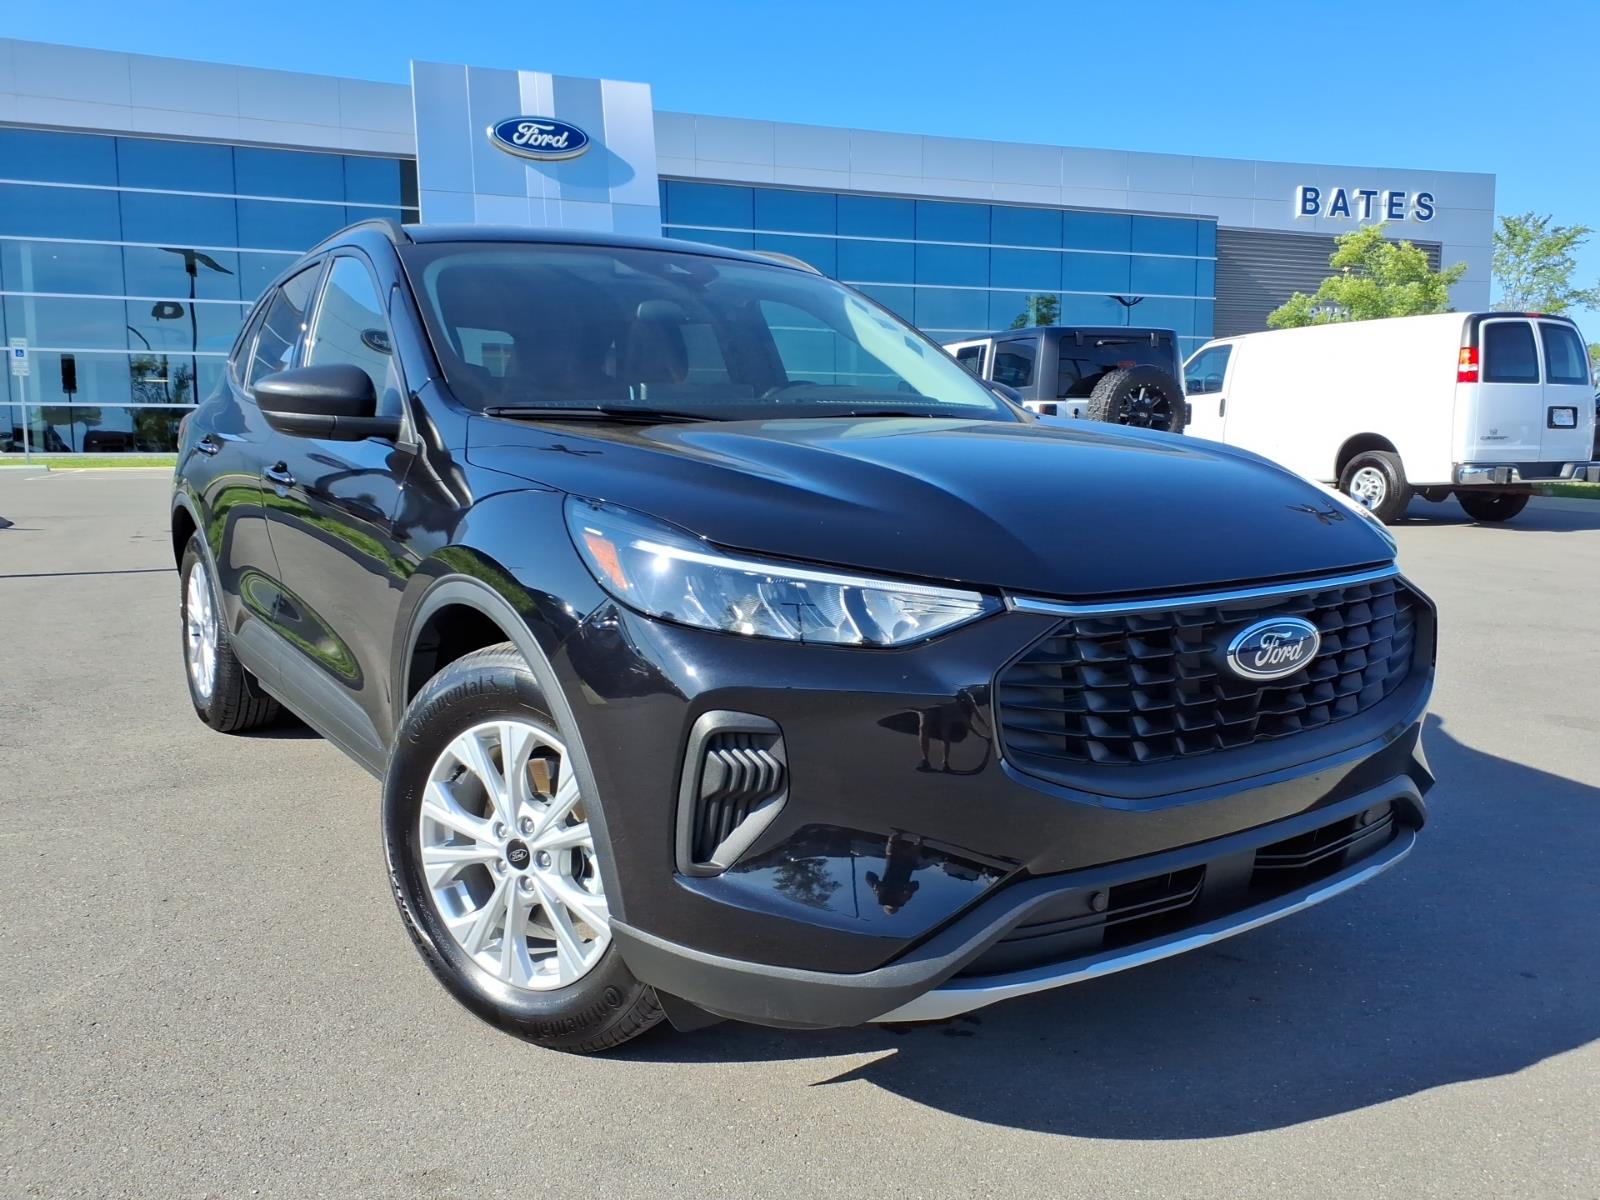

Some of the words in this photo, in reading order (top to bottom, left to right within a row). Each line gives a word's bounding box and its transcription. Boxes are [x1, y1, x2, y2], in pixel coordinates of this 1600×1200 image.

[512, 122, 568, 148] Ford
[1296, 185, 1436, 222] BATES
[1254, 631, 1304, 667] Ford
